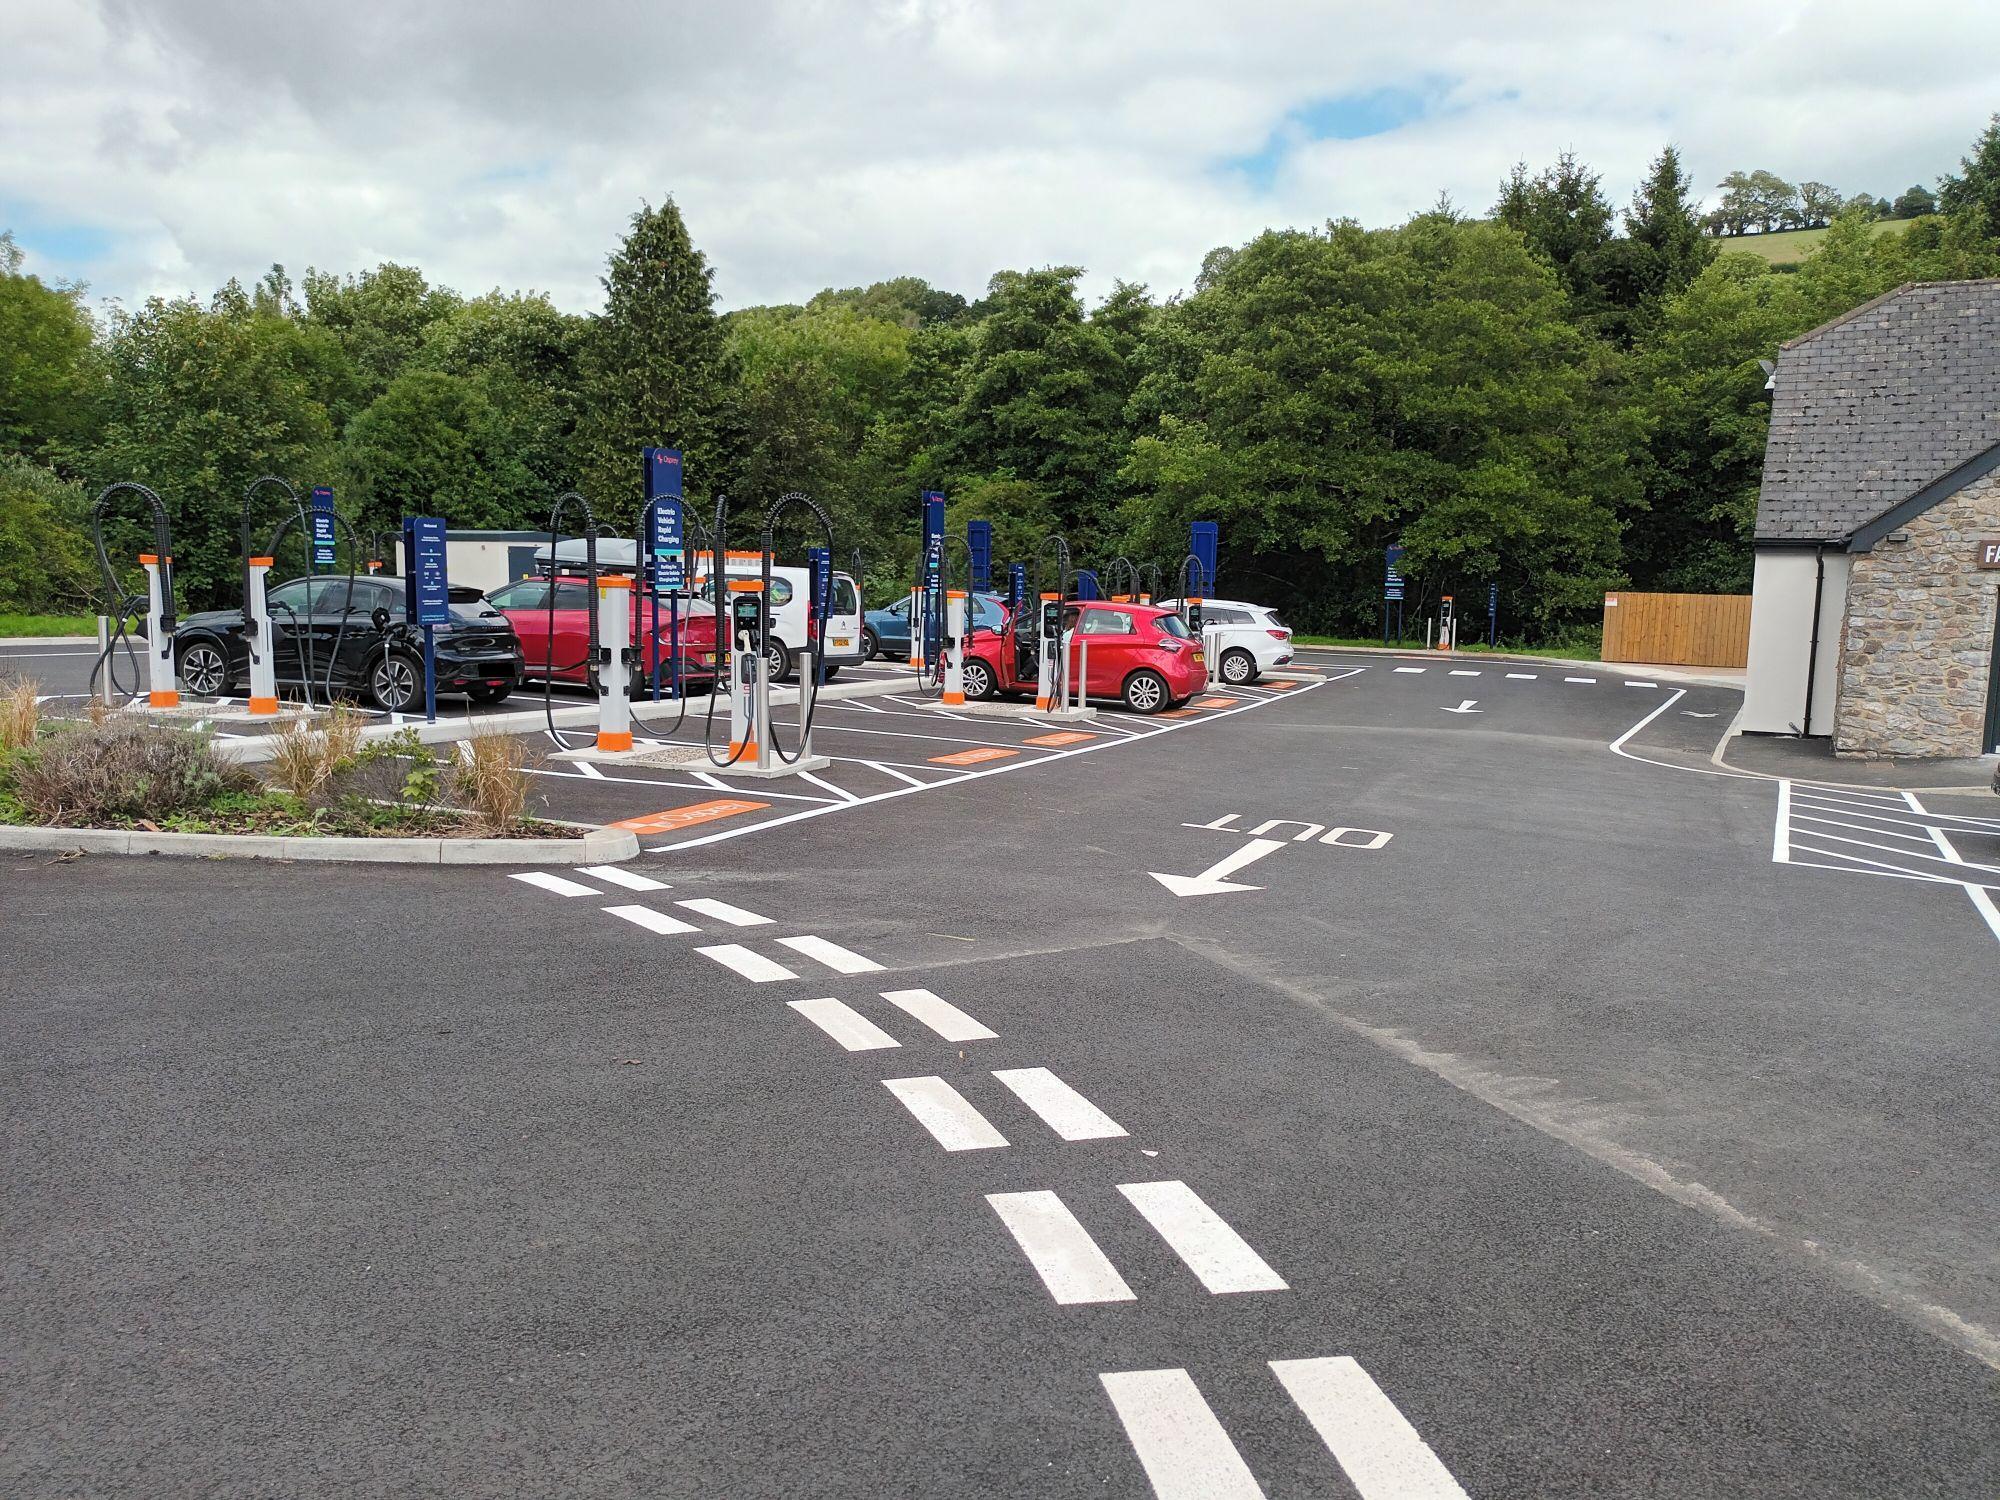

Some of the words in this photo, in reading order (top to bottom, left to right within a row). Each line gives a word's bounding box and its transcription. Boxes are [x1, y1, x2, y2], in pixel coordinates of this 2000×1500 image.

[657, 508, 675, 516] Electric
[657, 516, 675, 525] Vehicle
[658, 526, 672, 535] Rapid
[658, 535, 680, 545] Charging
[659, 803, 750, 822] Osprey
[1180, 813, 1395, 850] OUT
